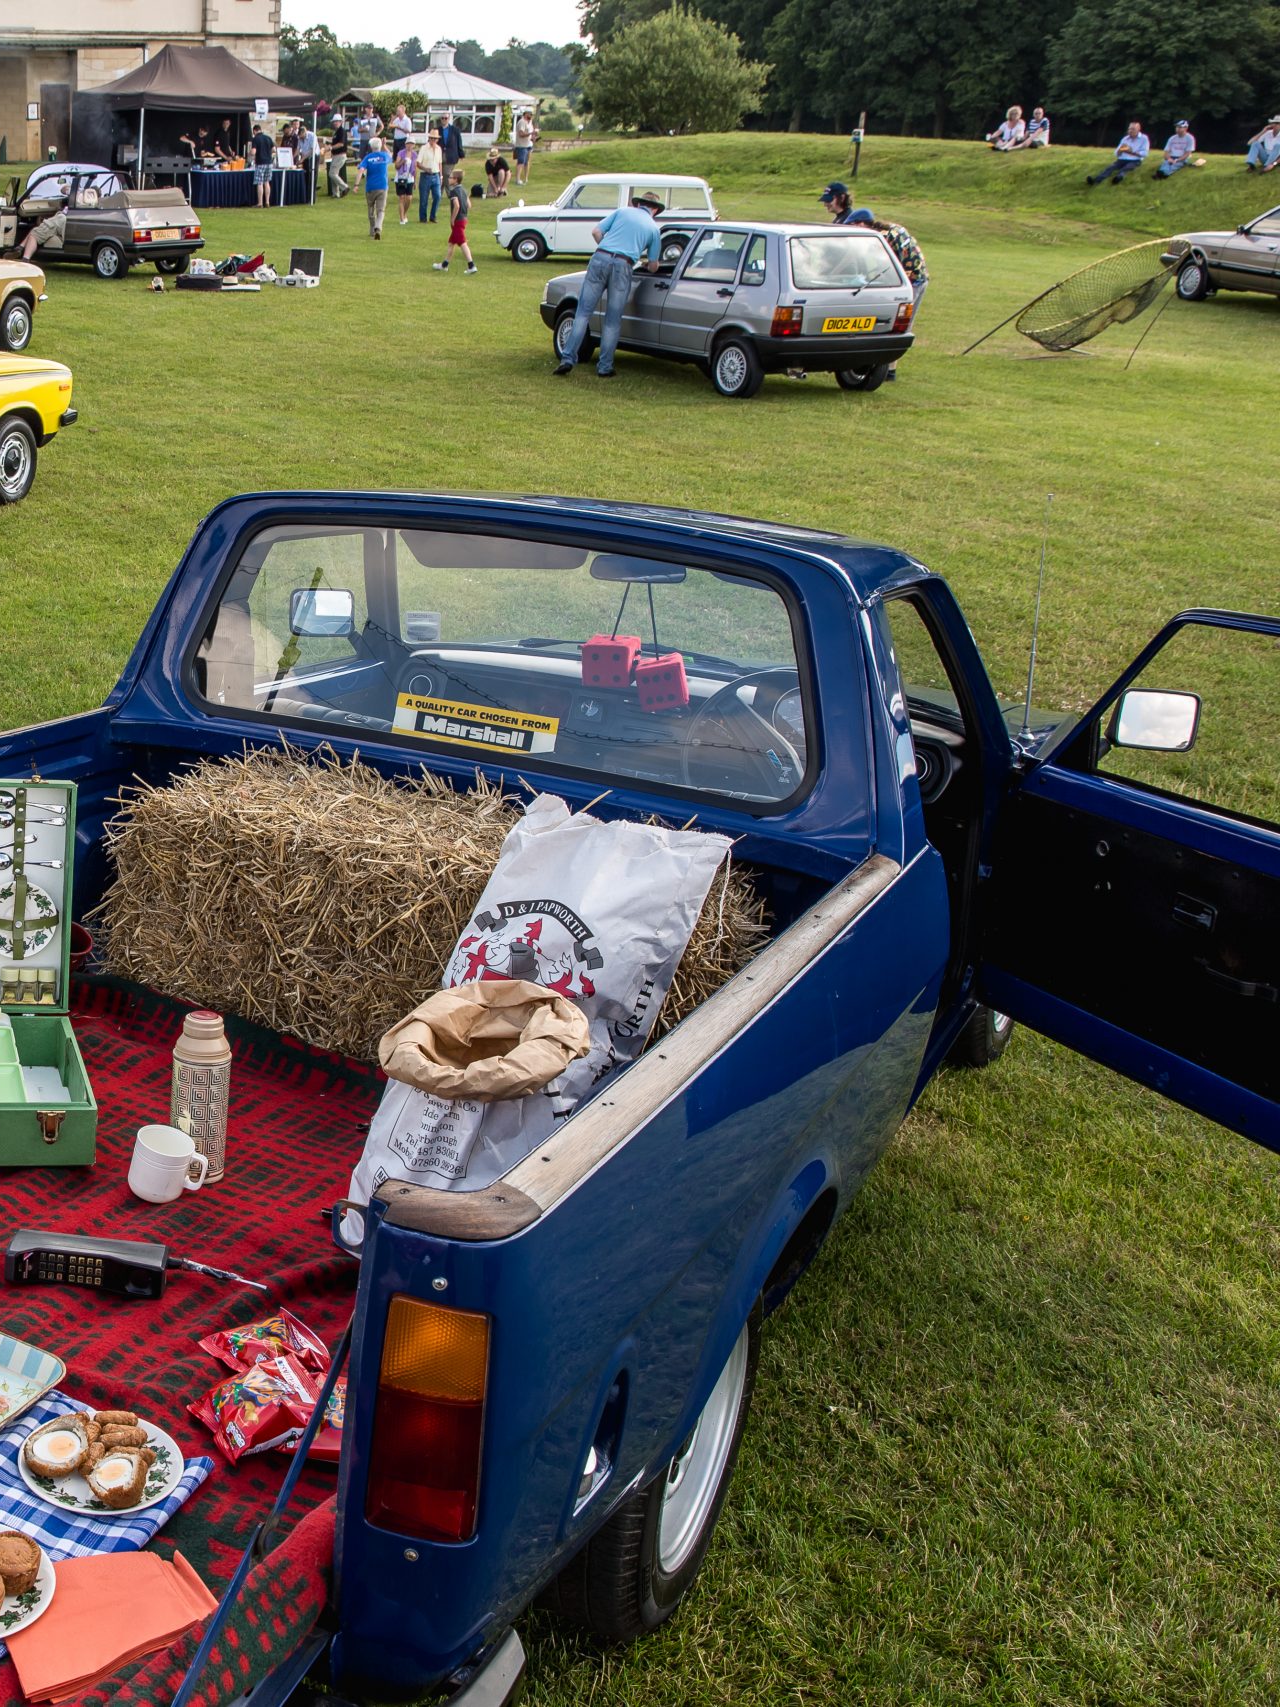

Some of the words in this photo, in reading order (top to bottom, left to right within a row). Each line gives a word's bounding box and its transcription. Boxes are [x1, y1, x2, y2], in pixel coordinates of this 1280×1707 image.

[826, 319, 850, 330] D102
[851, 318, 872, 329] ALD
[405, 699, 412, 707] A
[415, 700, 455, 714] QUALITY
[457, 708, 477, 719] CAR
[480, 712, 518, 726] CHOSEN
[521, 719, 551, 731] FROM
[422, 715, 525, 748] Marshall
[504, 906, 515, 917] D
[519, 903, 528, 914] &
[528, 902, 535, 913] J
[535, 901, 588, 940] PAPWORTH
